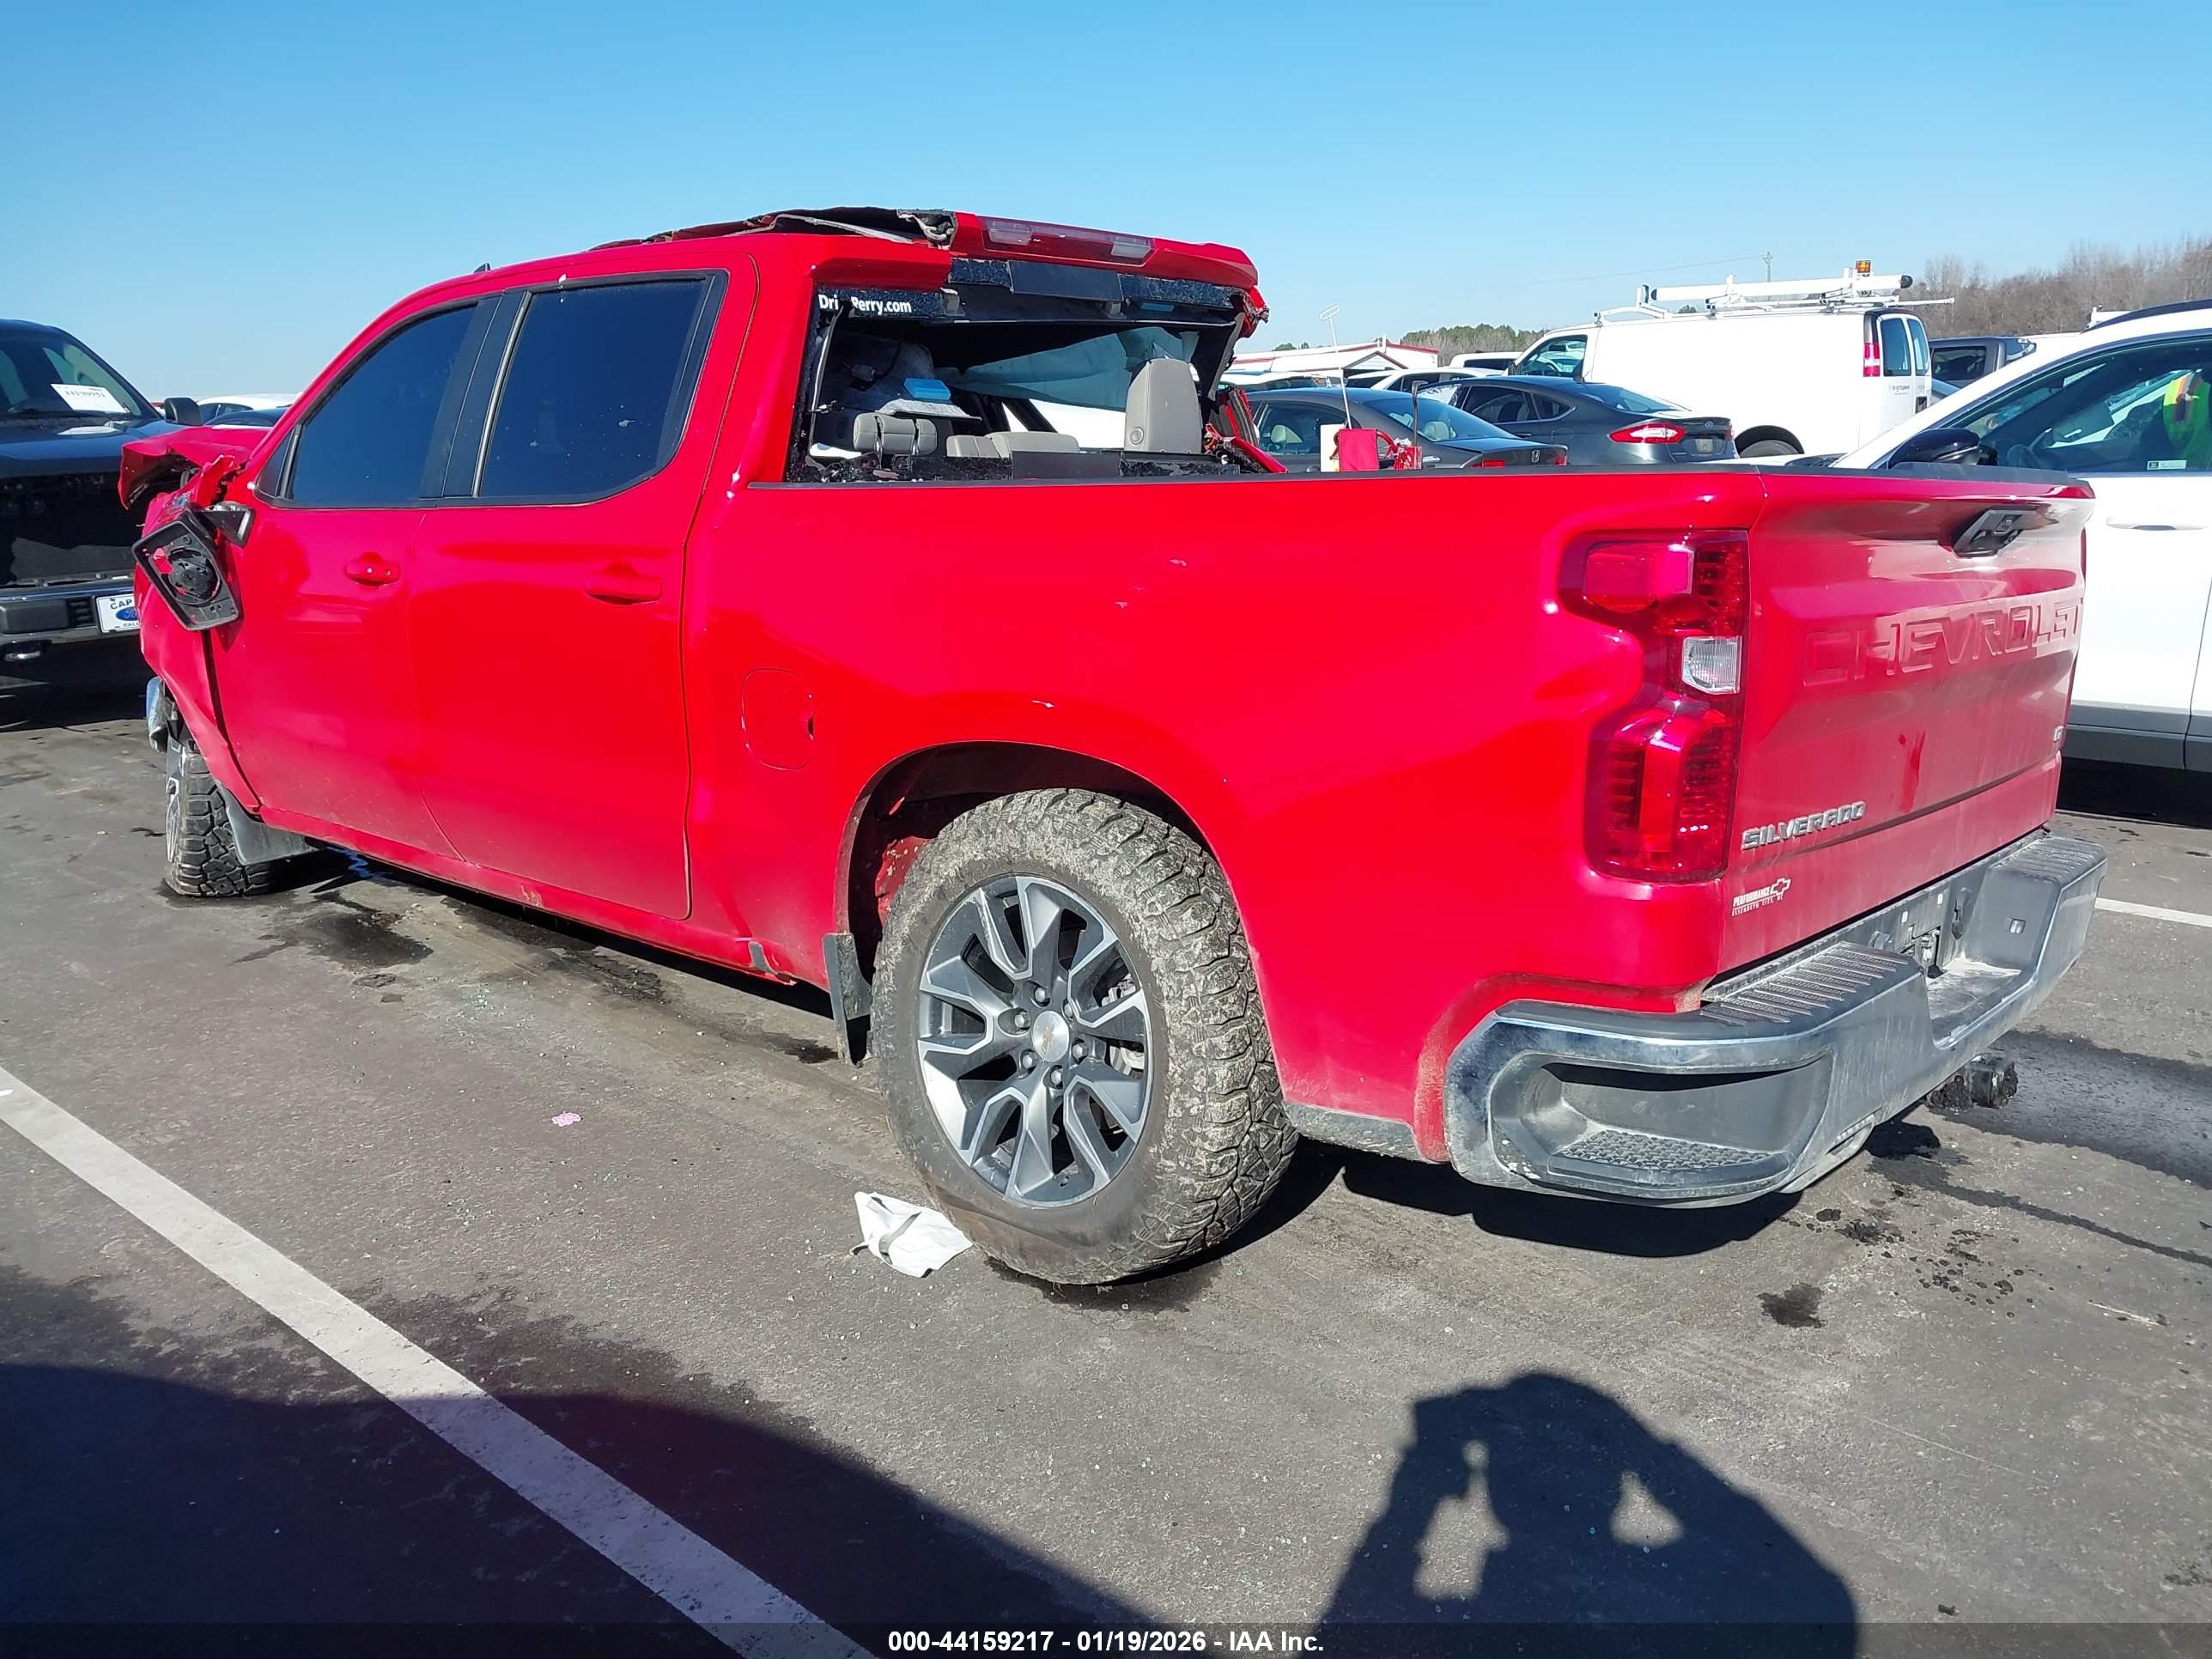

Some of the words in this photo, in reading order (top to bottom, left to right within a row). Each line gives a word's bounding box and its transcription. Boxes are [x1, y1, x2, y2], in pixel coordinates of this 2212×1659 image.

[818, 294, 912, 315] DriPerry.com
[110, 599, 132, 610] CAP
[1803, 598, 2084, 687] CHEVROLET
[1741, 800, 1867, 850] SILVERADO
[1732, 886, 1771, 908] PERFORMANCE
[1731, 902, 1760, 917] ELIZABETH
